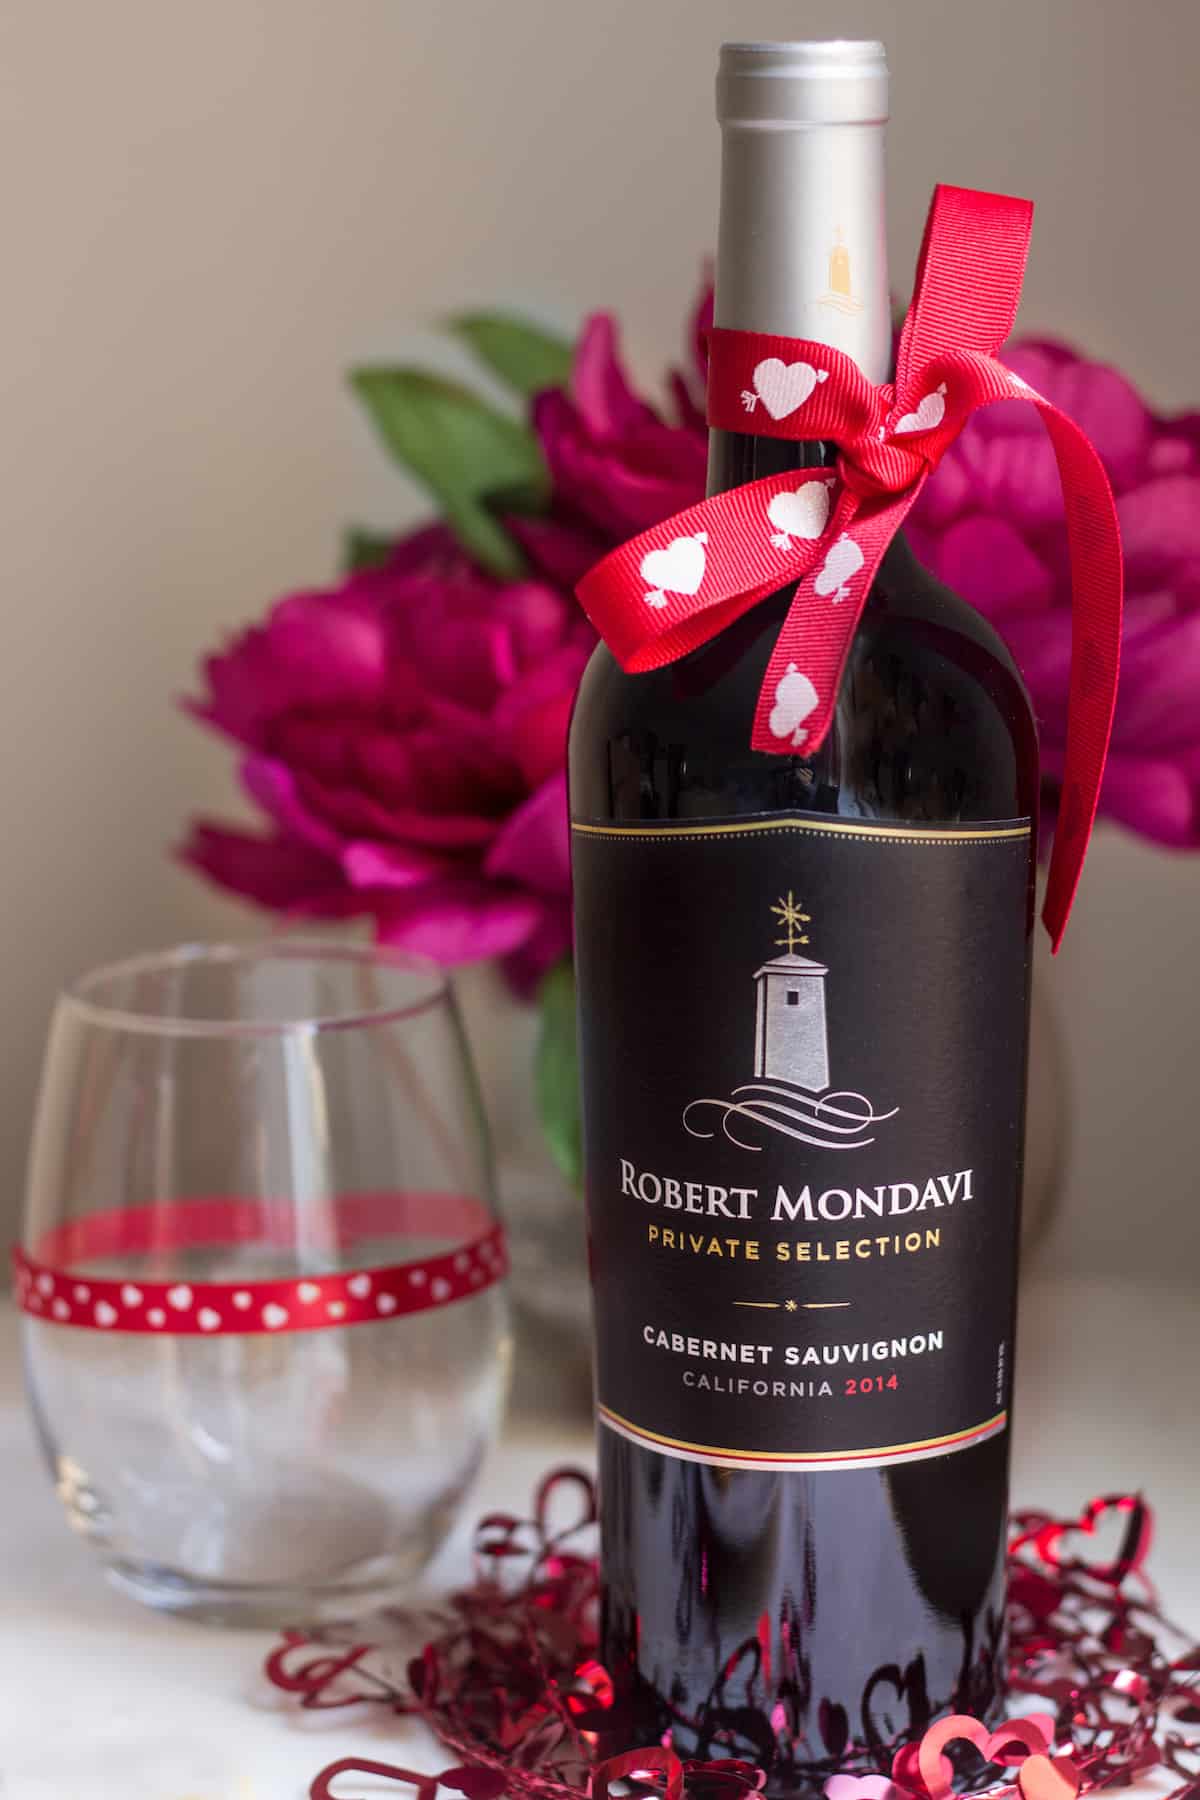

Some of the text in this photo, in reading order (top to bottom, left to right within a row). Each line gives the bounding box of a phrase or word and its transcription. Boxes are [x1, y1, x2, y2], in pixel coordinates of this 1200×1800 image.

[621, 1158, 974, 1221] ROBERT MONDAVI
[648, 1225, 941, 1261] PRIVATE SELECTION
[643, 1325, 944, 1366] CABERNET SAUVIGNON
[683, 1371, 899, 1397] CALIFORNIA 2014
